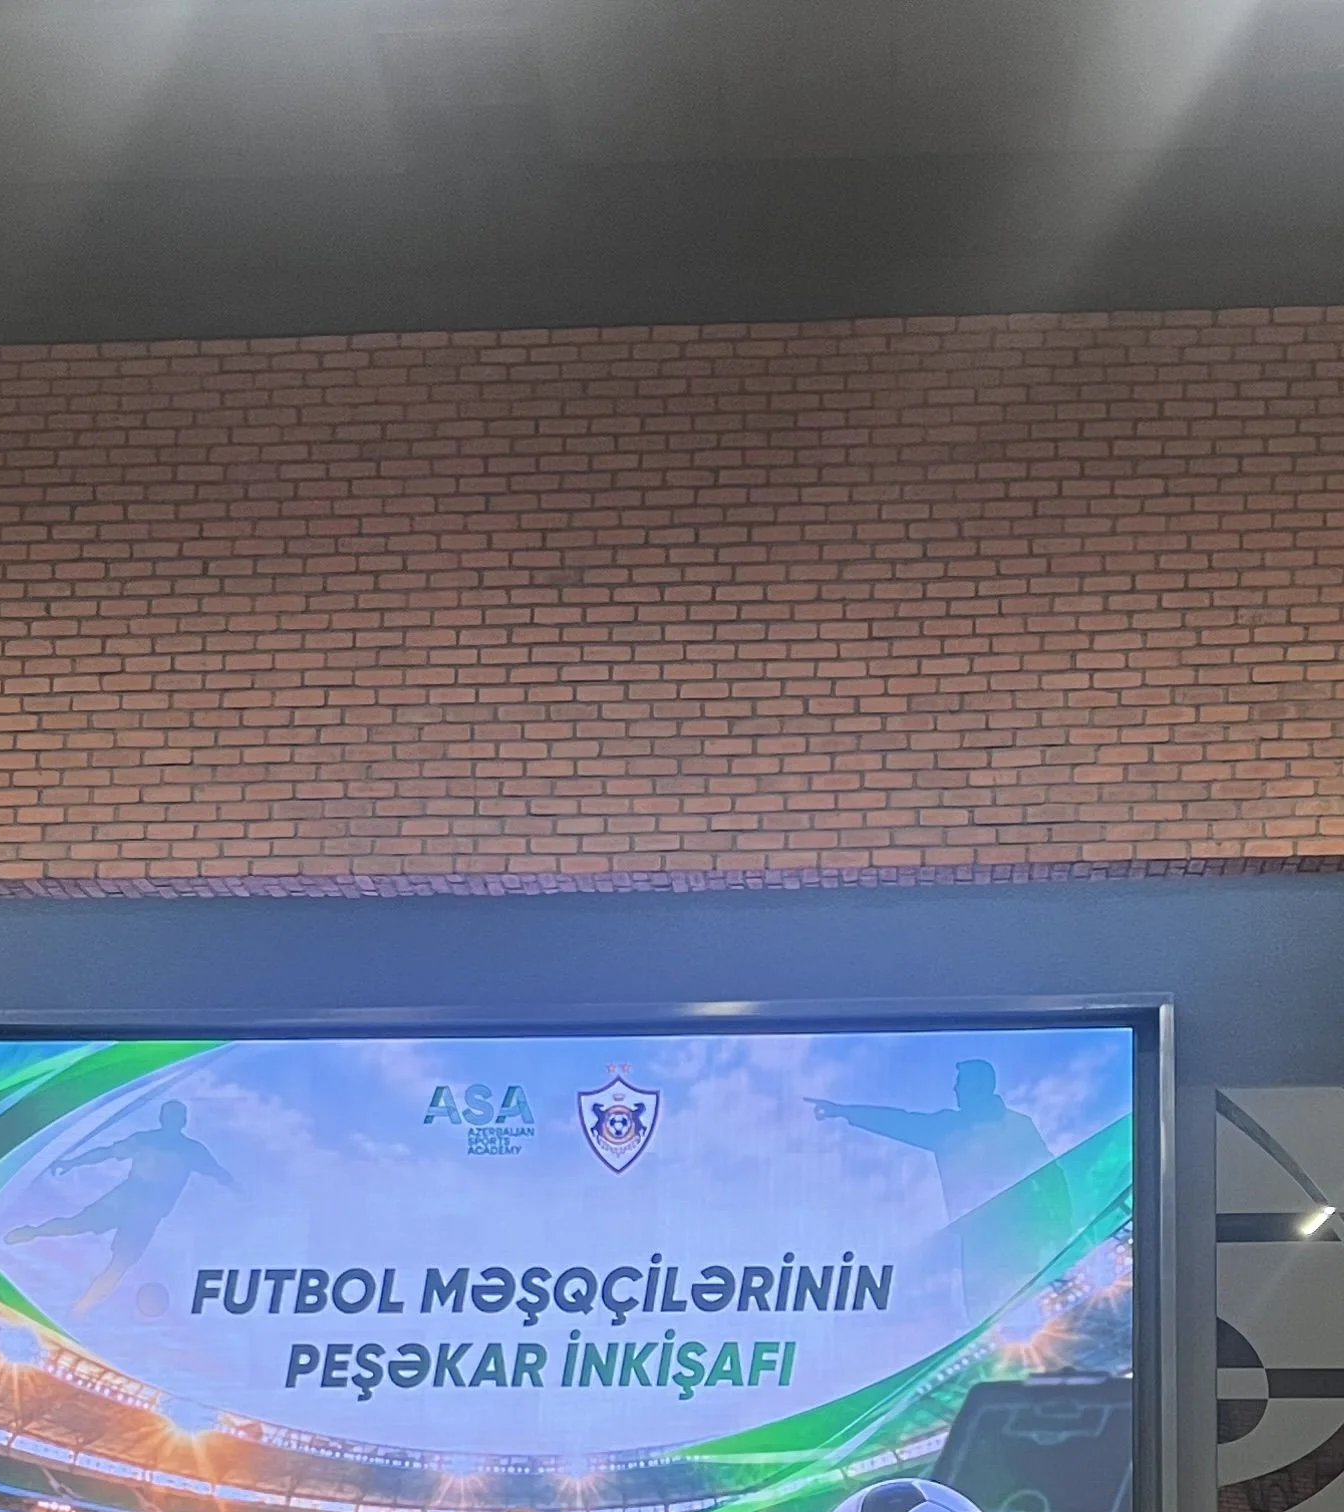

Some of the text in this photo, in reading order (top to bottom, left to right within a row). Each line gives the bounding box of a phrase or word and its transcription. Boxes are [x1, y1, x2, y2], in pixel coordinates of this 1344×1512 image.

[423, 1084, 535, 1126] ASA
[191, 1250, 895, 1327] FUTBOL MƏŞQÇİLƏRİNİN
[284, 1328, 797, 1402] PEŞƏKAR İNKİŞAFI
